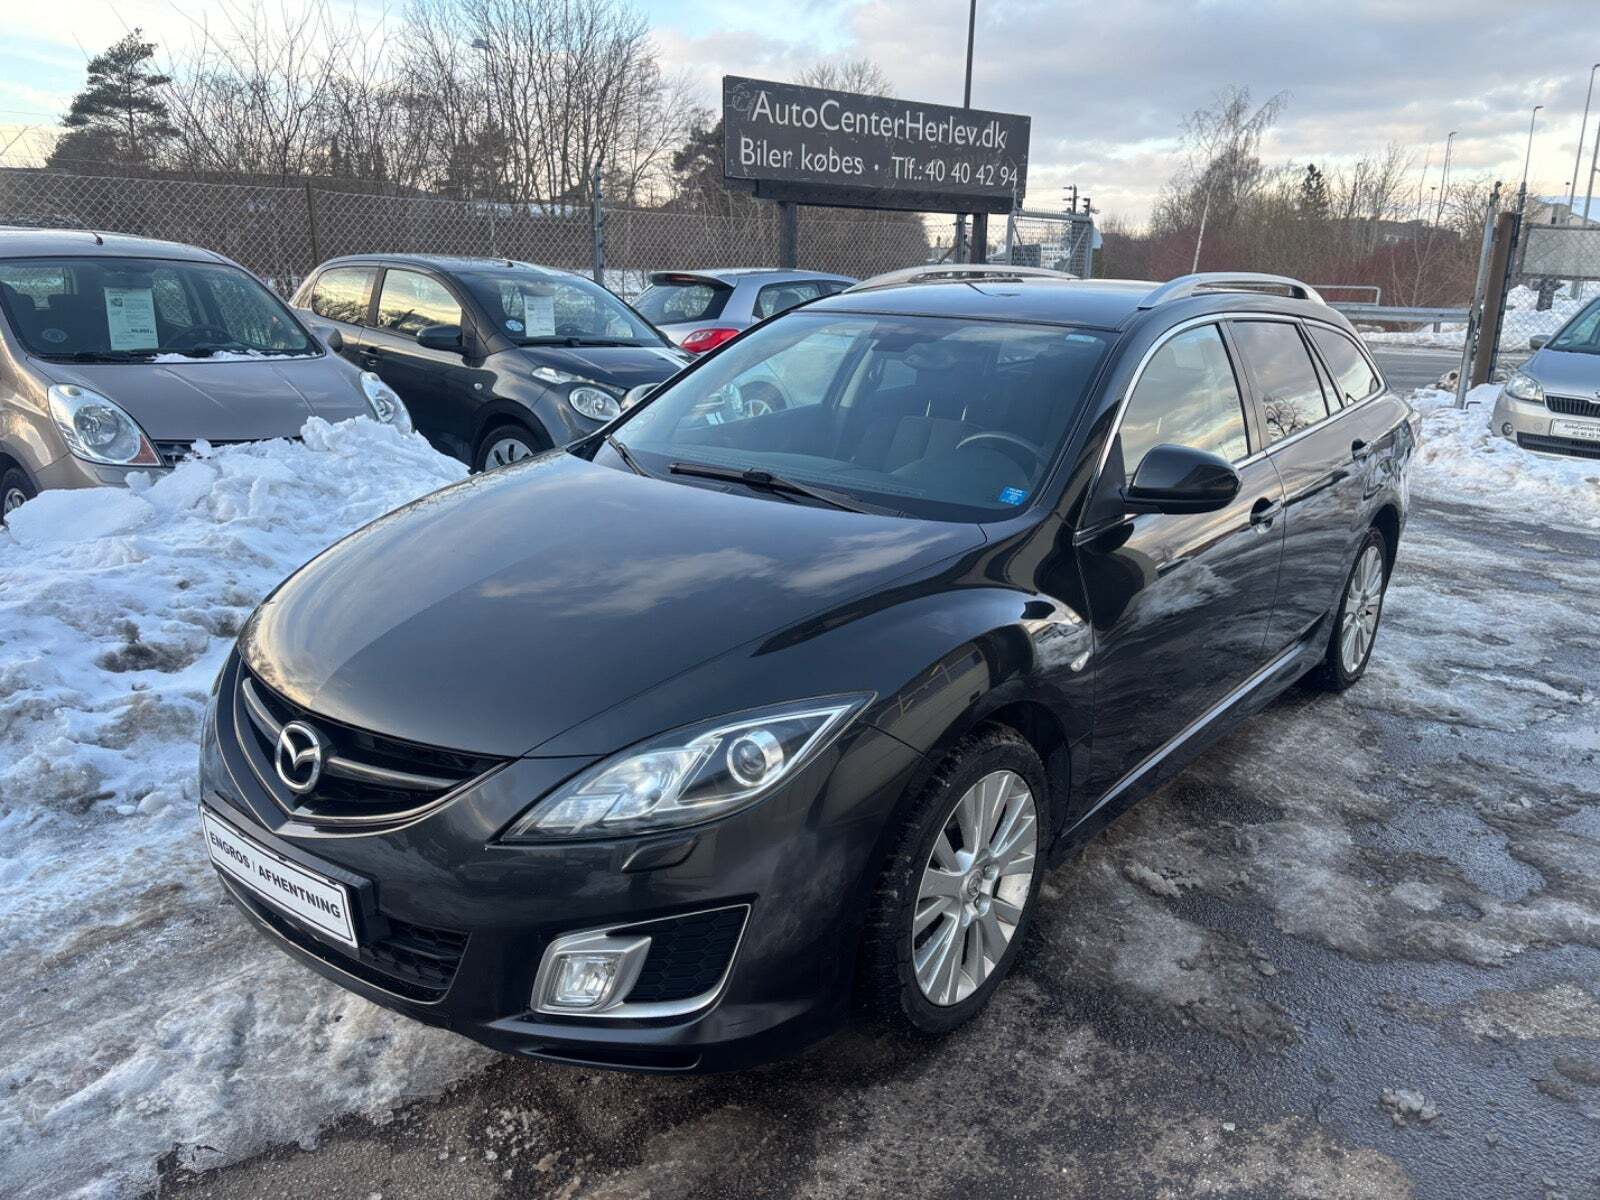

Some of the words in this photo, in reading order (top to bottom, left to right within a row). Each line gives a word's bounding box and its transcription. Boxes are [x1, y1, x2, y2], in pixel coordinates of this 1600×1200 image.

[751, 90, 1007, 149] AutoCenterHerlev.dk
[740, 136, 793, 169] Biler
[800, 143, 863, 176] købes
[950, 161, 970, 184] 40
[975, 164, 995, 186] 42
[1000, 166, 1018, 187] 94
[209, 832, 250, 868] ENGROS
[258, 865, 341, 919] AFHENTNING
